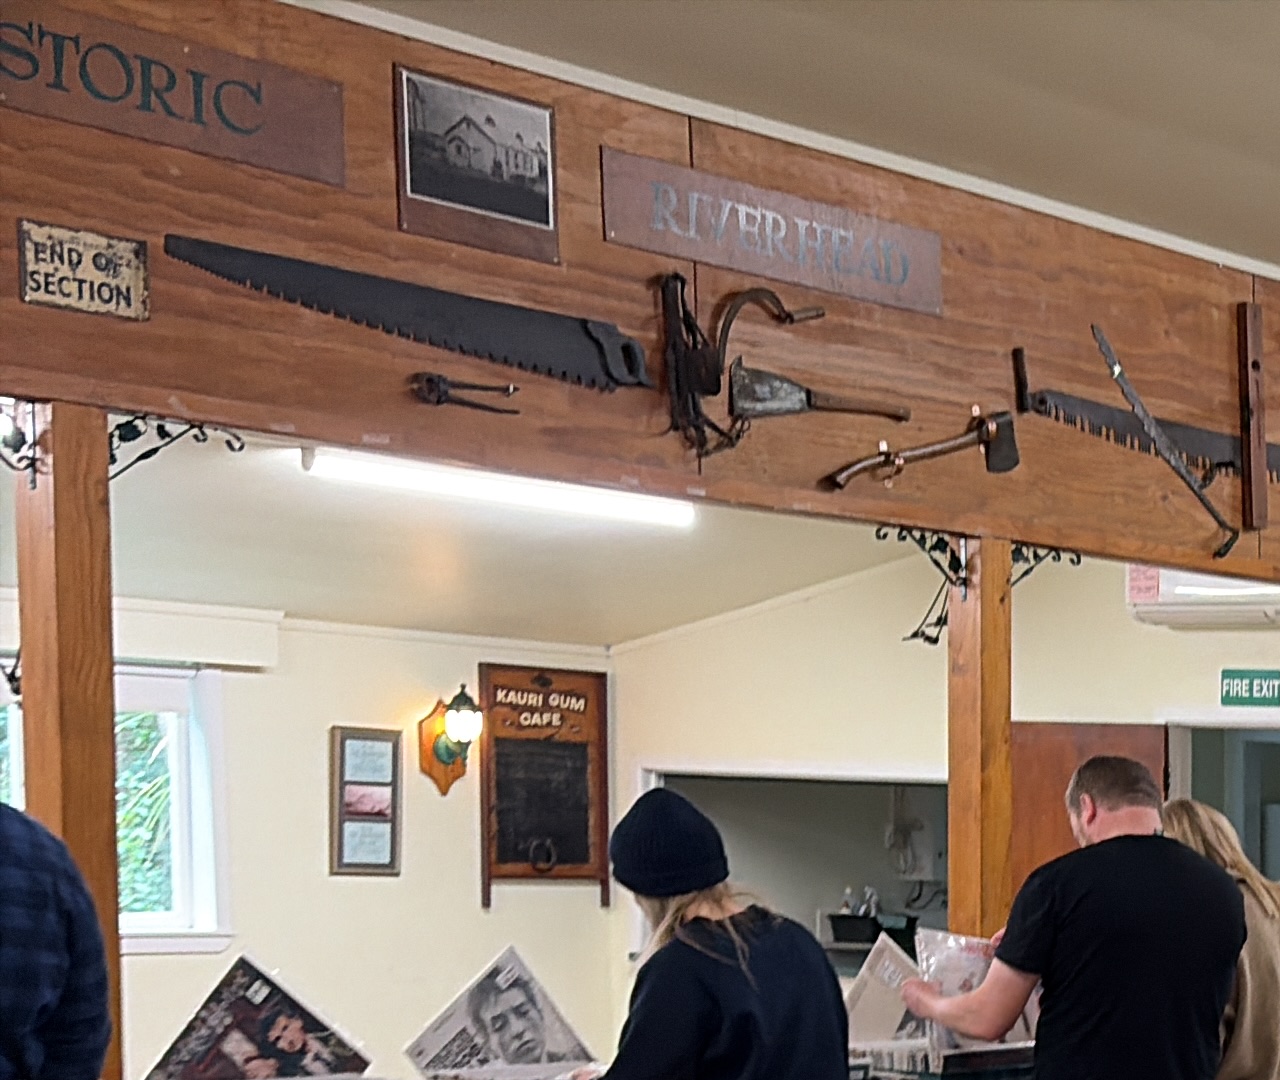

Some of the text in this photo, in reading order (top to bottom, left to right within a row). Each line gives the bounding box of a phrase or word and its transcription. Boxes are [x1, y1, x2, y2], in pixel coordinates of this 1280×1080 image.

[0, 21, 265, 136] STORIC
[650, 181, 910, 287] RIVERHEAD
[33, 240, 82, 266] END
[29, 270, 132, 310] SECTION
[496, 687, 543, 708] KAURI
[1223, 678, 1280, 698] FIRE EXIT
